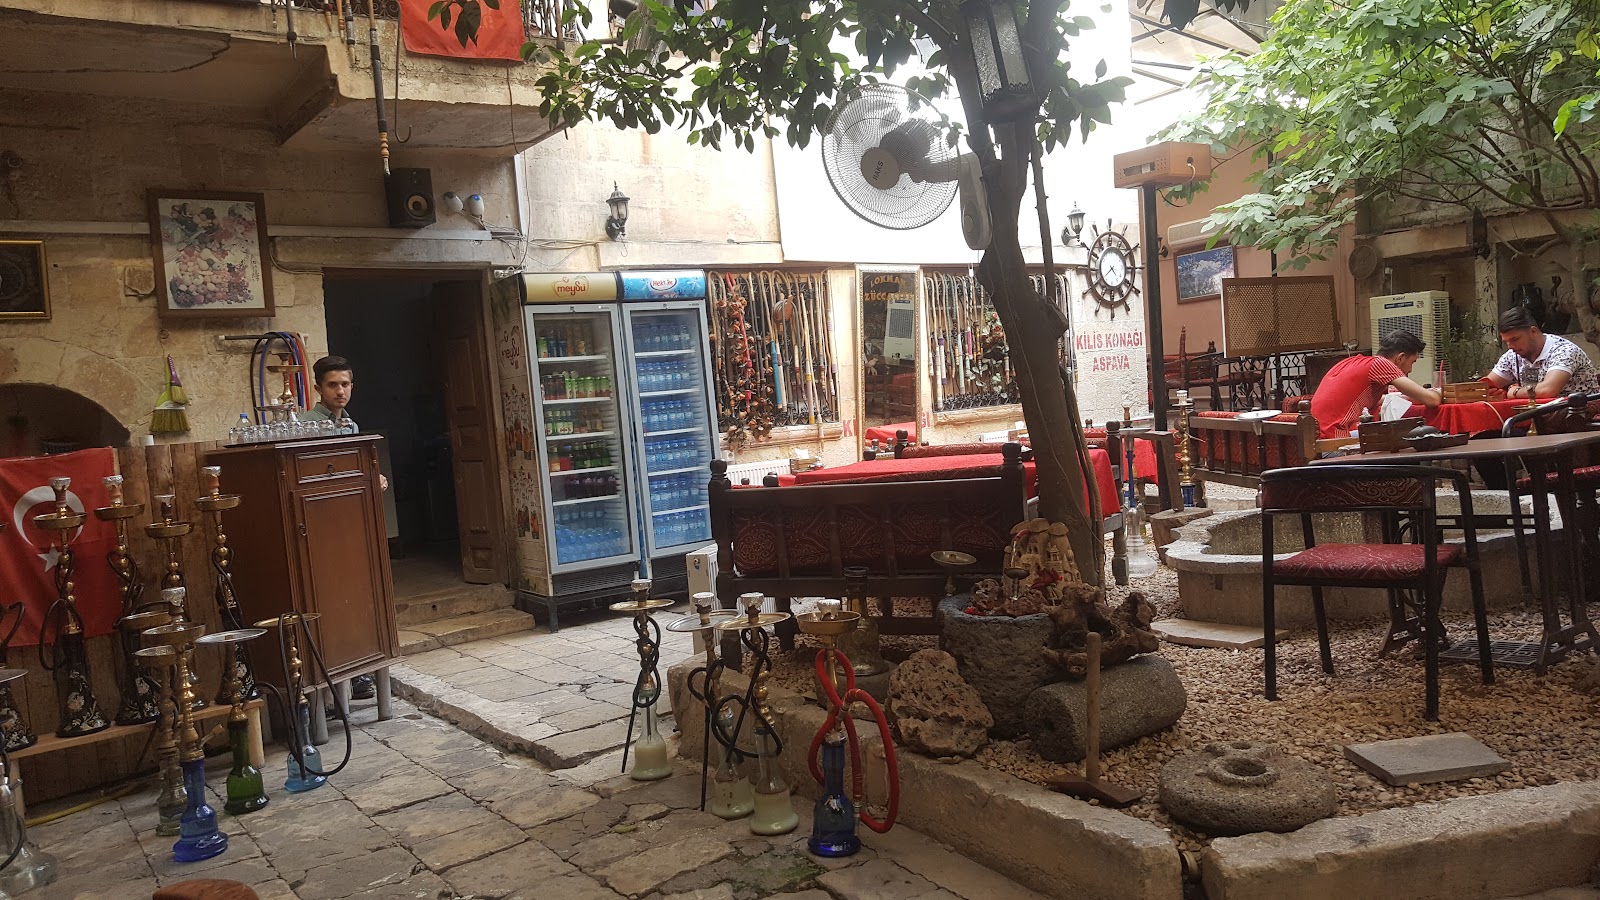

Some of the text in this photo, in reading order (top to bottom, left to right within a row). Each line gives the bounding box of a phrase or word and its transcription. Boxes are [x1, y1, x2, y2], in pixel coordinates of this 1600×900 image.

[1076, 329, 1143, 350] KİLİS KONAĞI
[1092, 355, 1130, 372] ASPAVA
